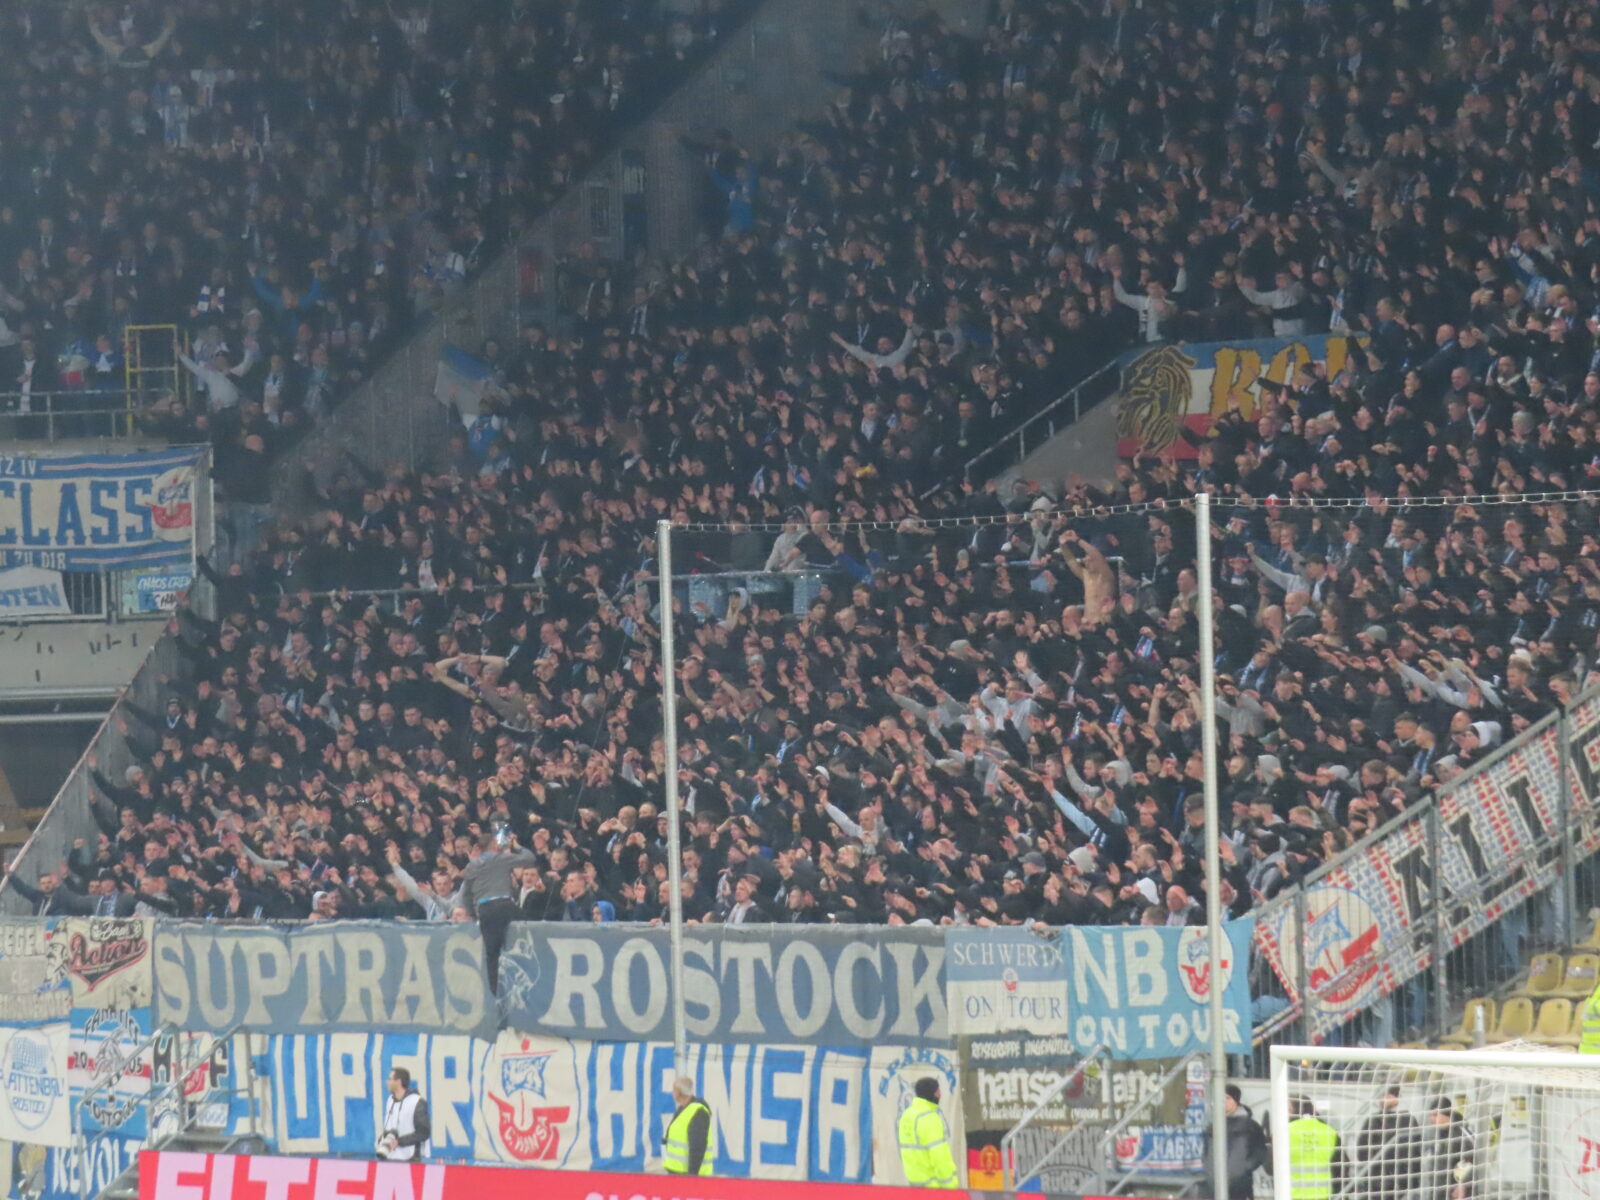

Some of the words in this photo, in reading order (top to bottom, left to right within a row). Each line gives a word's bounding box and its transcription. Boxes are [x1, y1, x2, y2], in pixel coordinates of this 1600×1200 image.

[153, 932, 486, 1030] SUPTRAS
[538, 936, 948, 1038] ROSTOCK
[966, 995, 993, 1019] ON
[1006, 995, 1062, 1020] TOUR
[1070, 928, 1169, 1010] NB
[1076, 1014, 1127, 1051] ON
[1138, 1008, 1242, 1048] TOUR
[228, 1033, 472, 1153] SUPER
